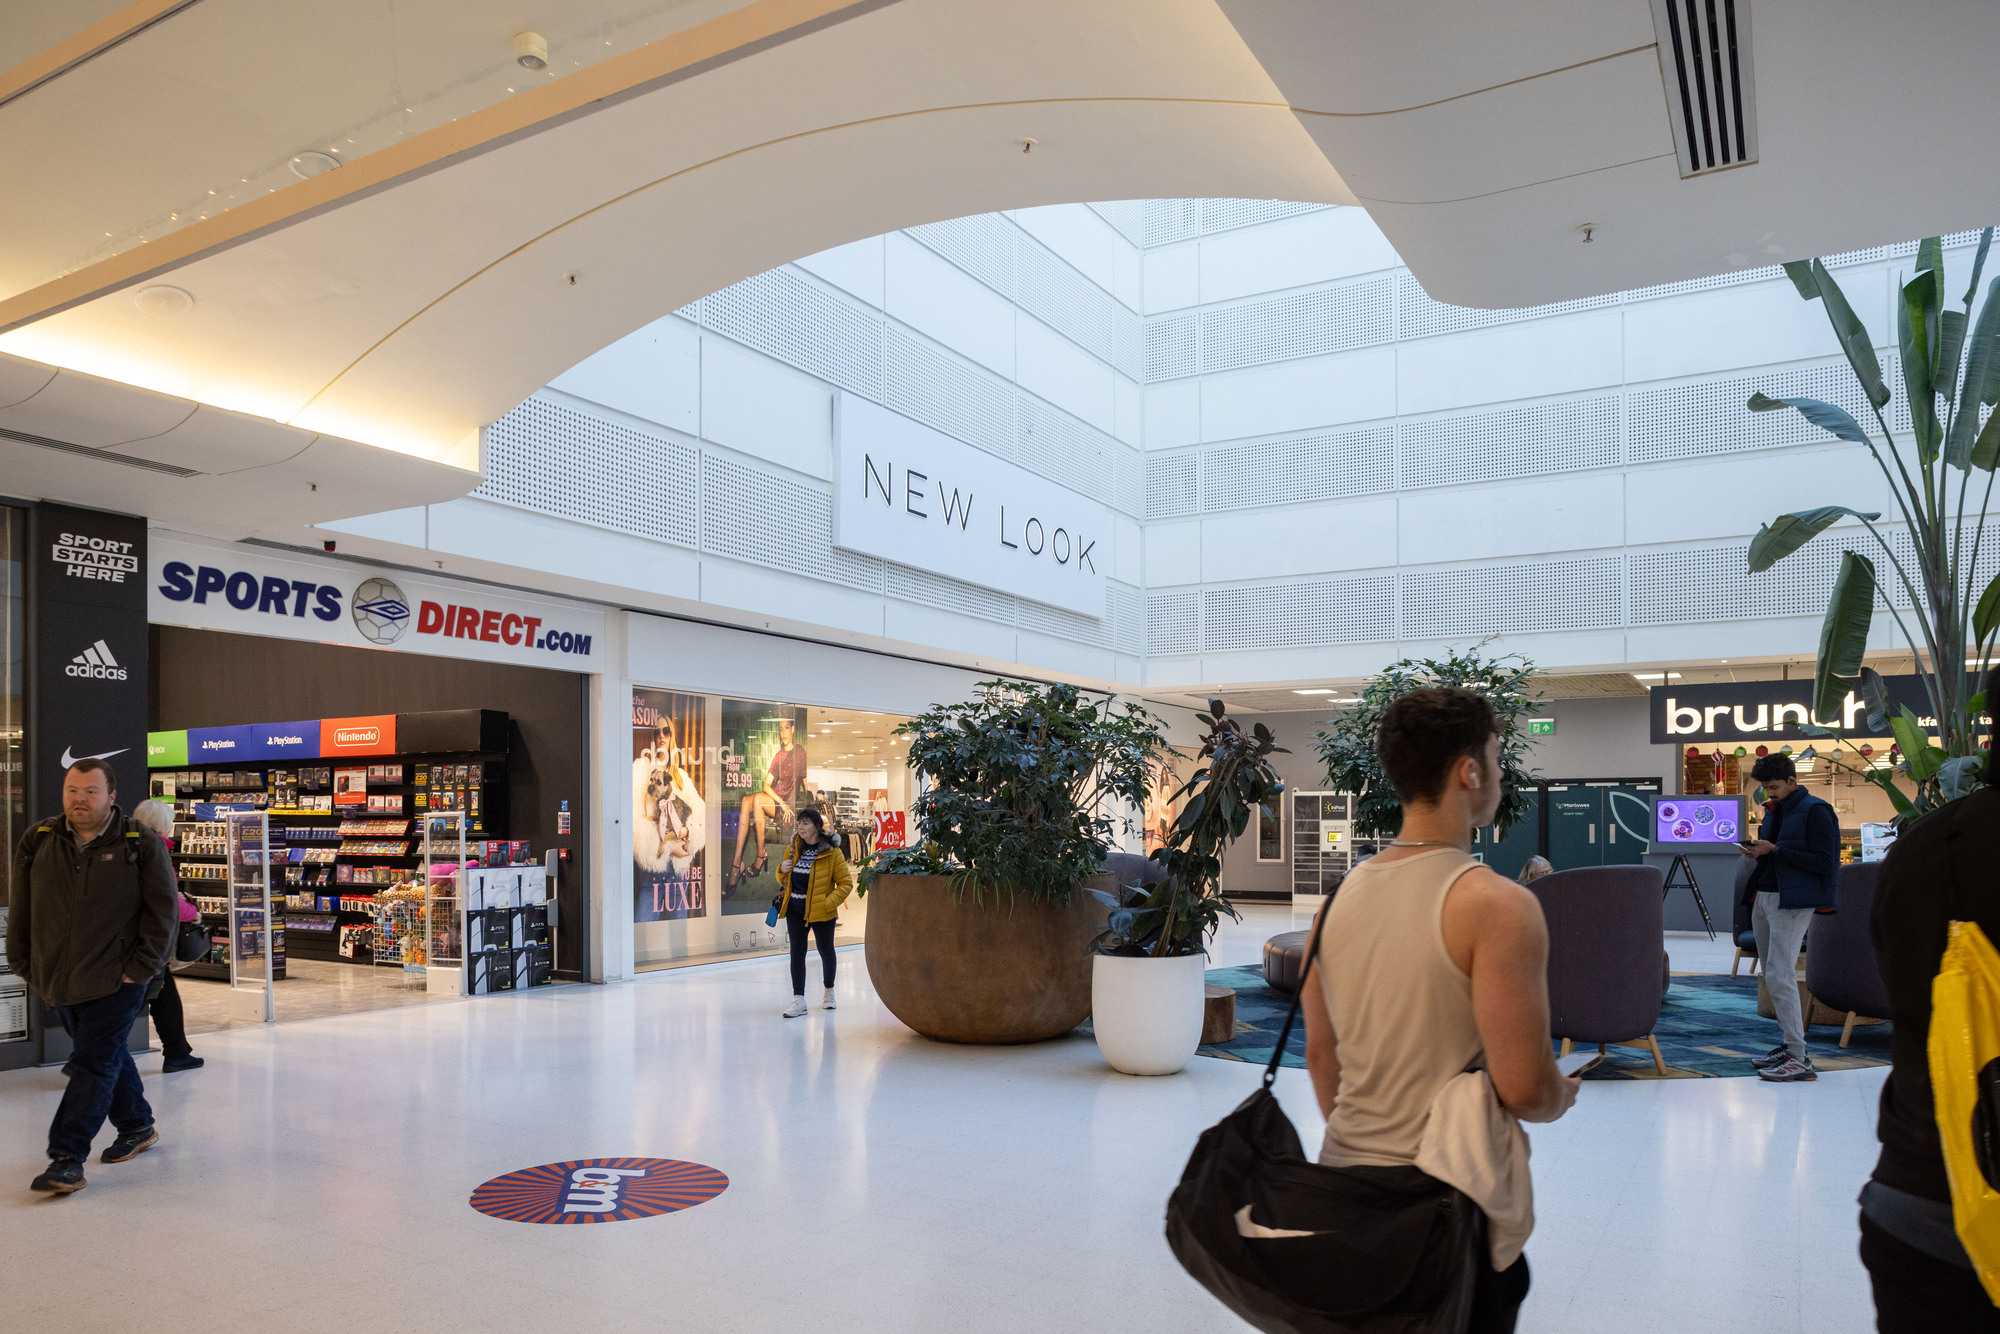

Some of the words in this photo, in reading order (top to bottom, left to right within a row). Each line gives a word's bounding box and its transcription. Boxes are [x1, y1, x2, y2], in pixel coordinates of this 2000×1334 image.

[863, 453, 973, 531] NEW
[1000, 505, 1096, 575] LOOK
[58, 532, 132, 554] SPORT
[56, 548, 135, 570] STARTS
[66, 564, 125, 583] HERE
[158, 561, 342, 622] SPORTS
[65, 664, 127, 681] adidas
[208, 740, 236, 751] PlayStation
[273, 735, 303, 747] PlayStation
[337, 731, 376, 742] Nintendo
[726, 772, 752, 788] £9.99
[681, 867, 690, 880] TO
[691, 867, 702, 880] BE
[652, 882, 702, 912] LUXE
[563, 1167, 646, 1214] b&m
